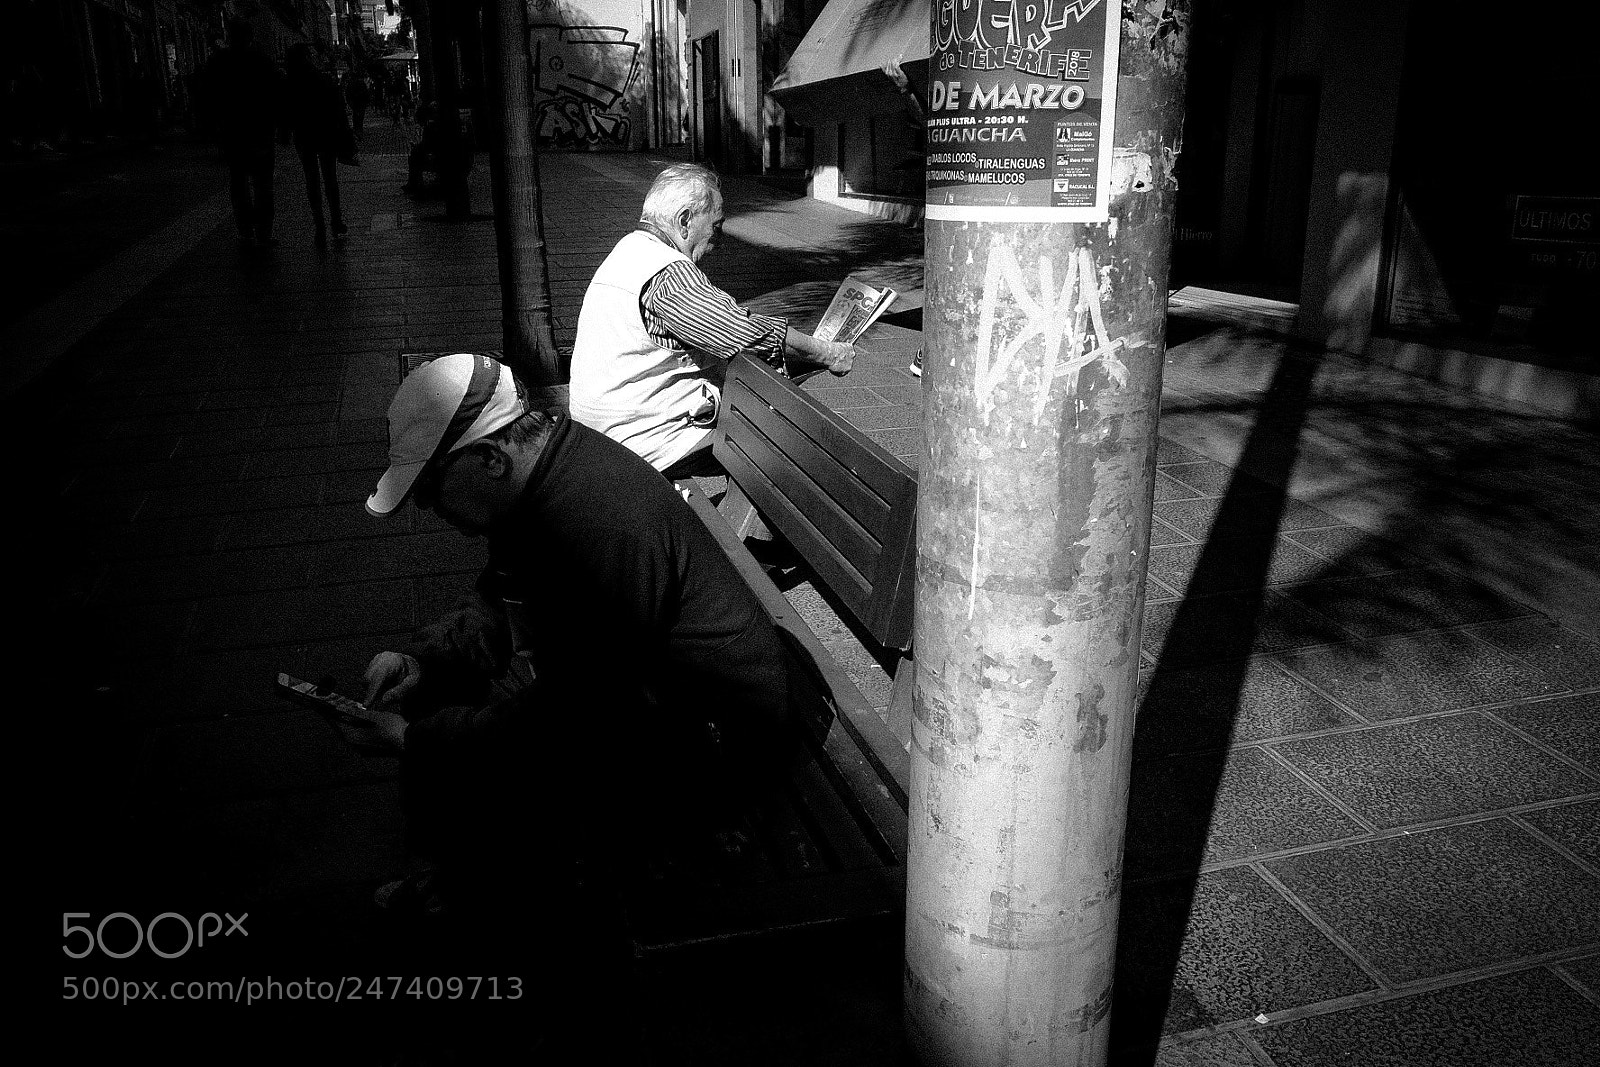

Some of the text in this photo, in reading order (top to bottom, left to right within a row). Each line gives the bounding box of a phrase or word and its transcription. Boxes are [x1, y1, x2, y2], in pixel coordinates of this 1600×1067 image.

[939, 39, 1092, 80] de TENERIFE
[1068, 50, 1081, 76] 2018
[932, 80, 1085, 111] DE MARZO
[936, 117, 950, 126] PLUS
[951, 116, 976, 125] ULTRA
[984, 115, 1014, 125] 20:30
[1017, 115, 1029, 124] H.
[931, 128, 1027, 143] GUANCHA
[952, 153, 977, 163] LOCOS
[978, 158, 1046, 169] TIRALENGUAS
[968, 172, 1025, 184] MAMELUCOS
